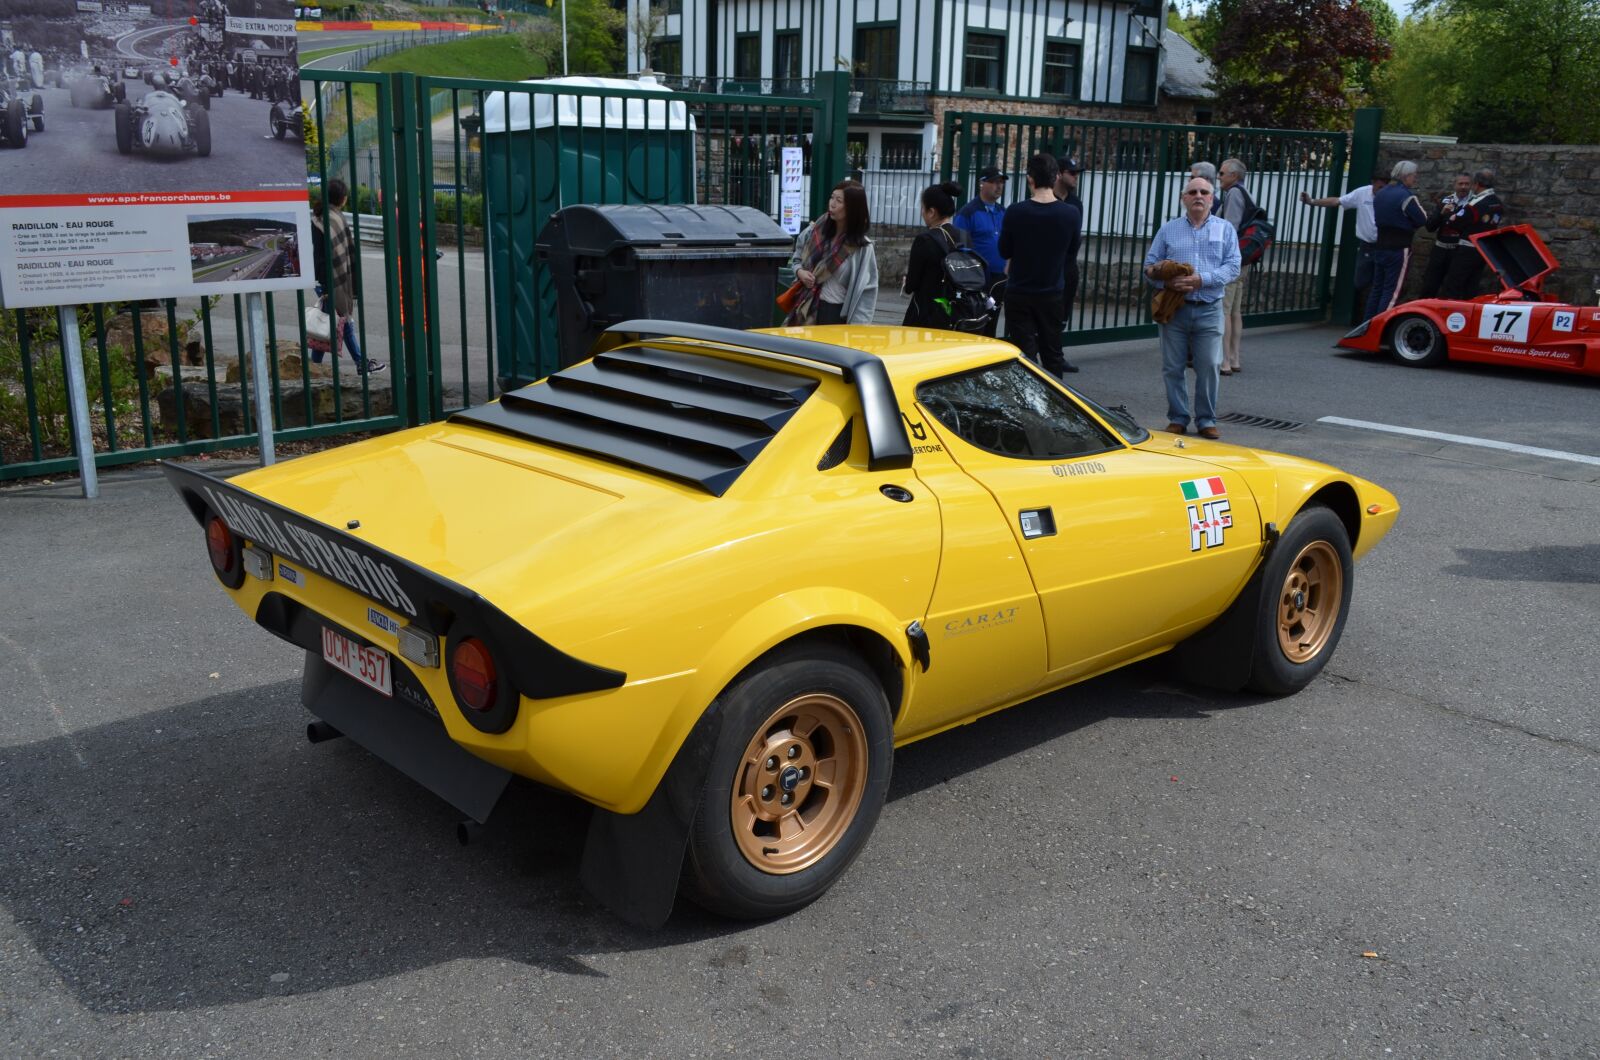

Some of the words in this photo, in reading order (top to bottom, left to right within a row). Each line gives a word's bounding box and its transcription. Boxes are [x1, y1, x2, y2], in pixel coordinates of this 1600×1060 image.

[245, 22, 266, 31] EXTRA
[268, 24, 293, 32] MOTOR
[88, 193, 231, 204] www.spa-francorchamps.be
[12, 222, 58, 230] RAIDILLON
[66, 221, 83, 229] EAU
[86, 220, 114, 228] ROUGE
[17, 261, 61, 270] RAIDILLON
[1493, 310, 1523, 333] 17
[1556, 316, 1570, 327] P2
[1492, 345, 1527, 355] Chateaux
[1528, 348, 1550, 357] Sport
[1550, 350, 1570, 359] Auto
[1051, 461, 1106, 477] STRATOS
[1187, 498, 1233, 553] HF
[203, 485, 300, 561] LANCIA
[283, 520, 417, 617] STRATOS
[945, 606, 1020, 631] CARAT
